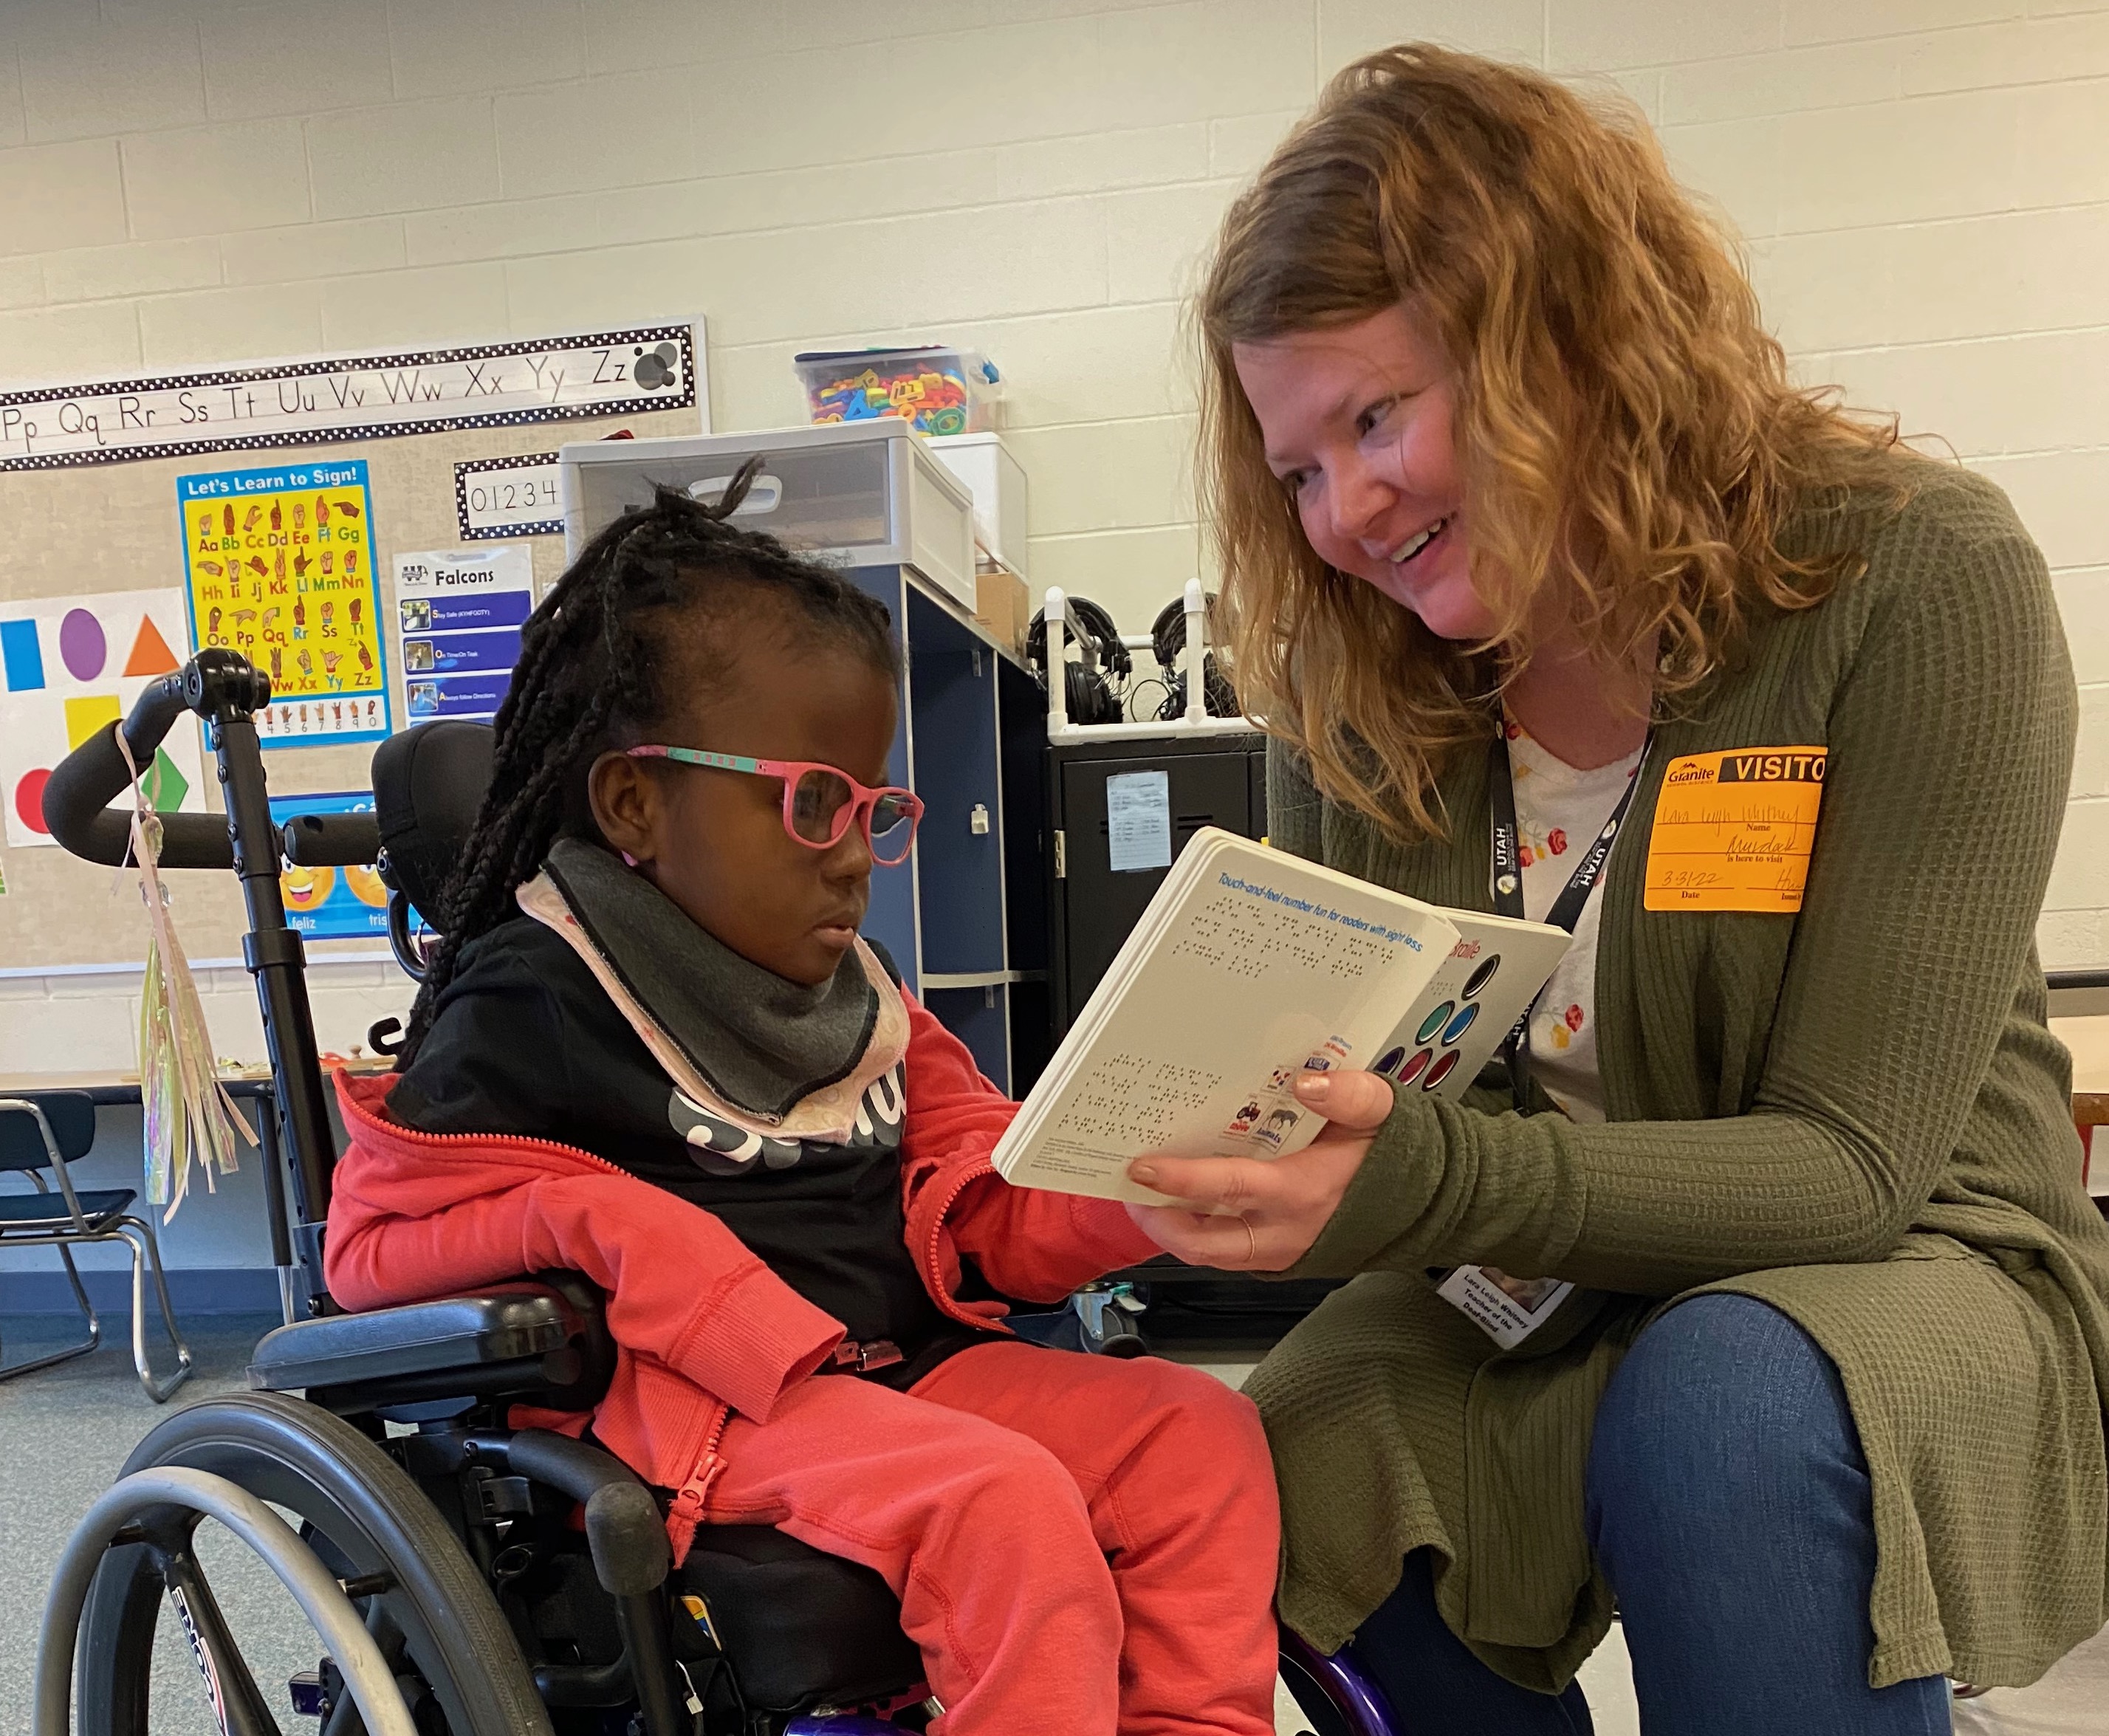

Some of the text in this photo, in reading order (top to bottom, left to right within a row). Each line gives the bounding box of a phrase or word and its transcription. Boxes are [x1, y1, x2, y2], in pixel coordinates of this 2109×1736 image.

[2, 349, 627, 453] Pp Qq Rr Ss Tt Uu Vv Ww Xx Yy Zz
[188, 467, 357, 495] Let's Learn to Sign!
[198, 526, 360, 553] Aa Bb Cc Dd Ee Ff Gg
[202, 575, 364, 603] Hh Ii Jj Kk Ll Mm Nn
[435, 569, 494, 586] Falcons
[207, 622, 364, 648] Oo Pp Qq Rr Ss Tt
[298, 676, 318, 690] Xx
[325, 674, 344, 691] Yy
[354, 673, 373, 687] Zz
[267, 725, 274, 734] 4
[284, 724, 291, 733] 5
[301, 723, 308, 733] 6
[319, 721, 324, 731] 7
[335, 720, 342, 730] 8
[352, 719, 359, 729] 9
[1669, 768, 1714, 783] Granite
[1746, 823, 1771, 831] Name
[1496, 828, 1507, 866] UTAH
[1735, 854, 1754, 862] here
[1766, 855, 1783, 863] visit
[1580, 848, 1606, 886] UTAH
[1681, 891, 1700, 899] Date
[292, 916, 316, 930] feliz
[1218, 872, 1423, 952] Touch-and-feel number fun for readers with sight loss
[1464, 1274, 1529, 1329] Lara Leigh Whitney
[1464, 1289, 1513, 1331] Teacher of the
[1463, 1302, 1500, 1333] Deaf-Blind
